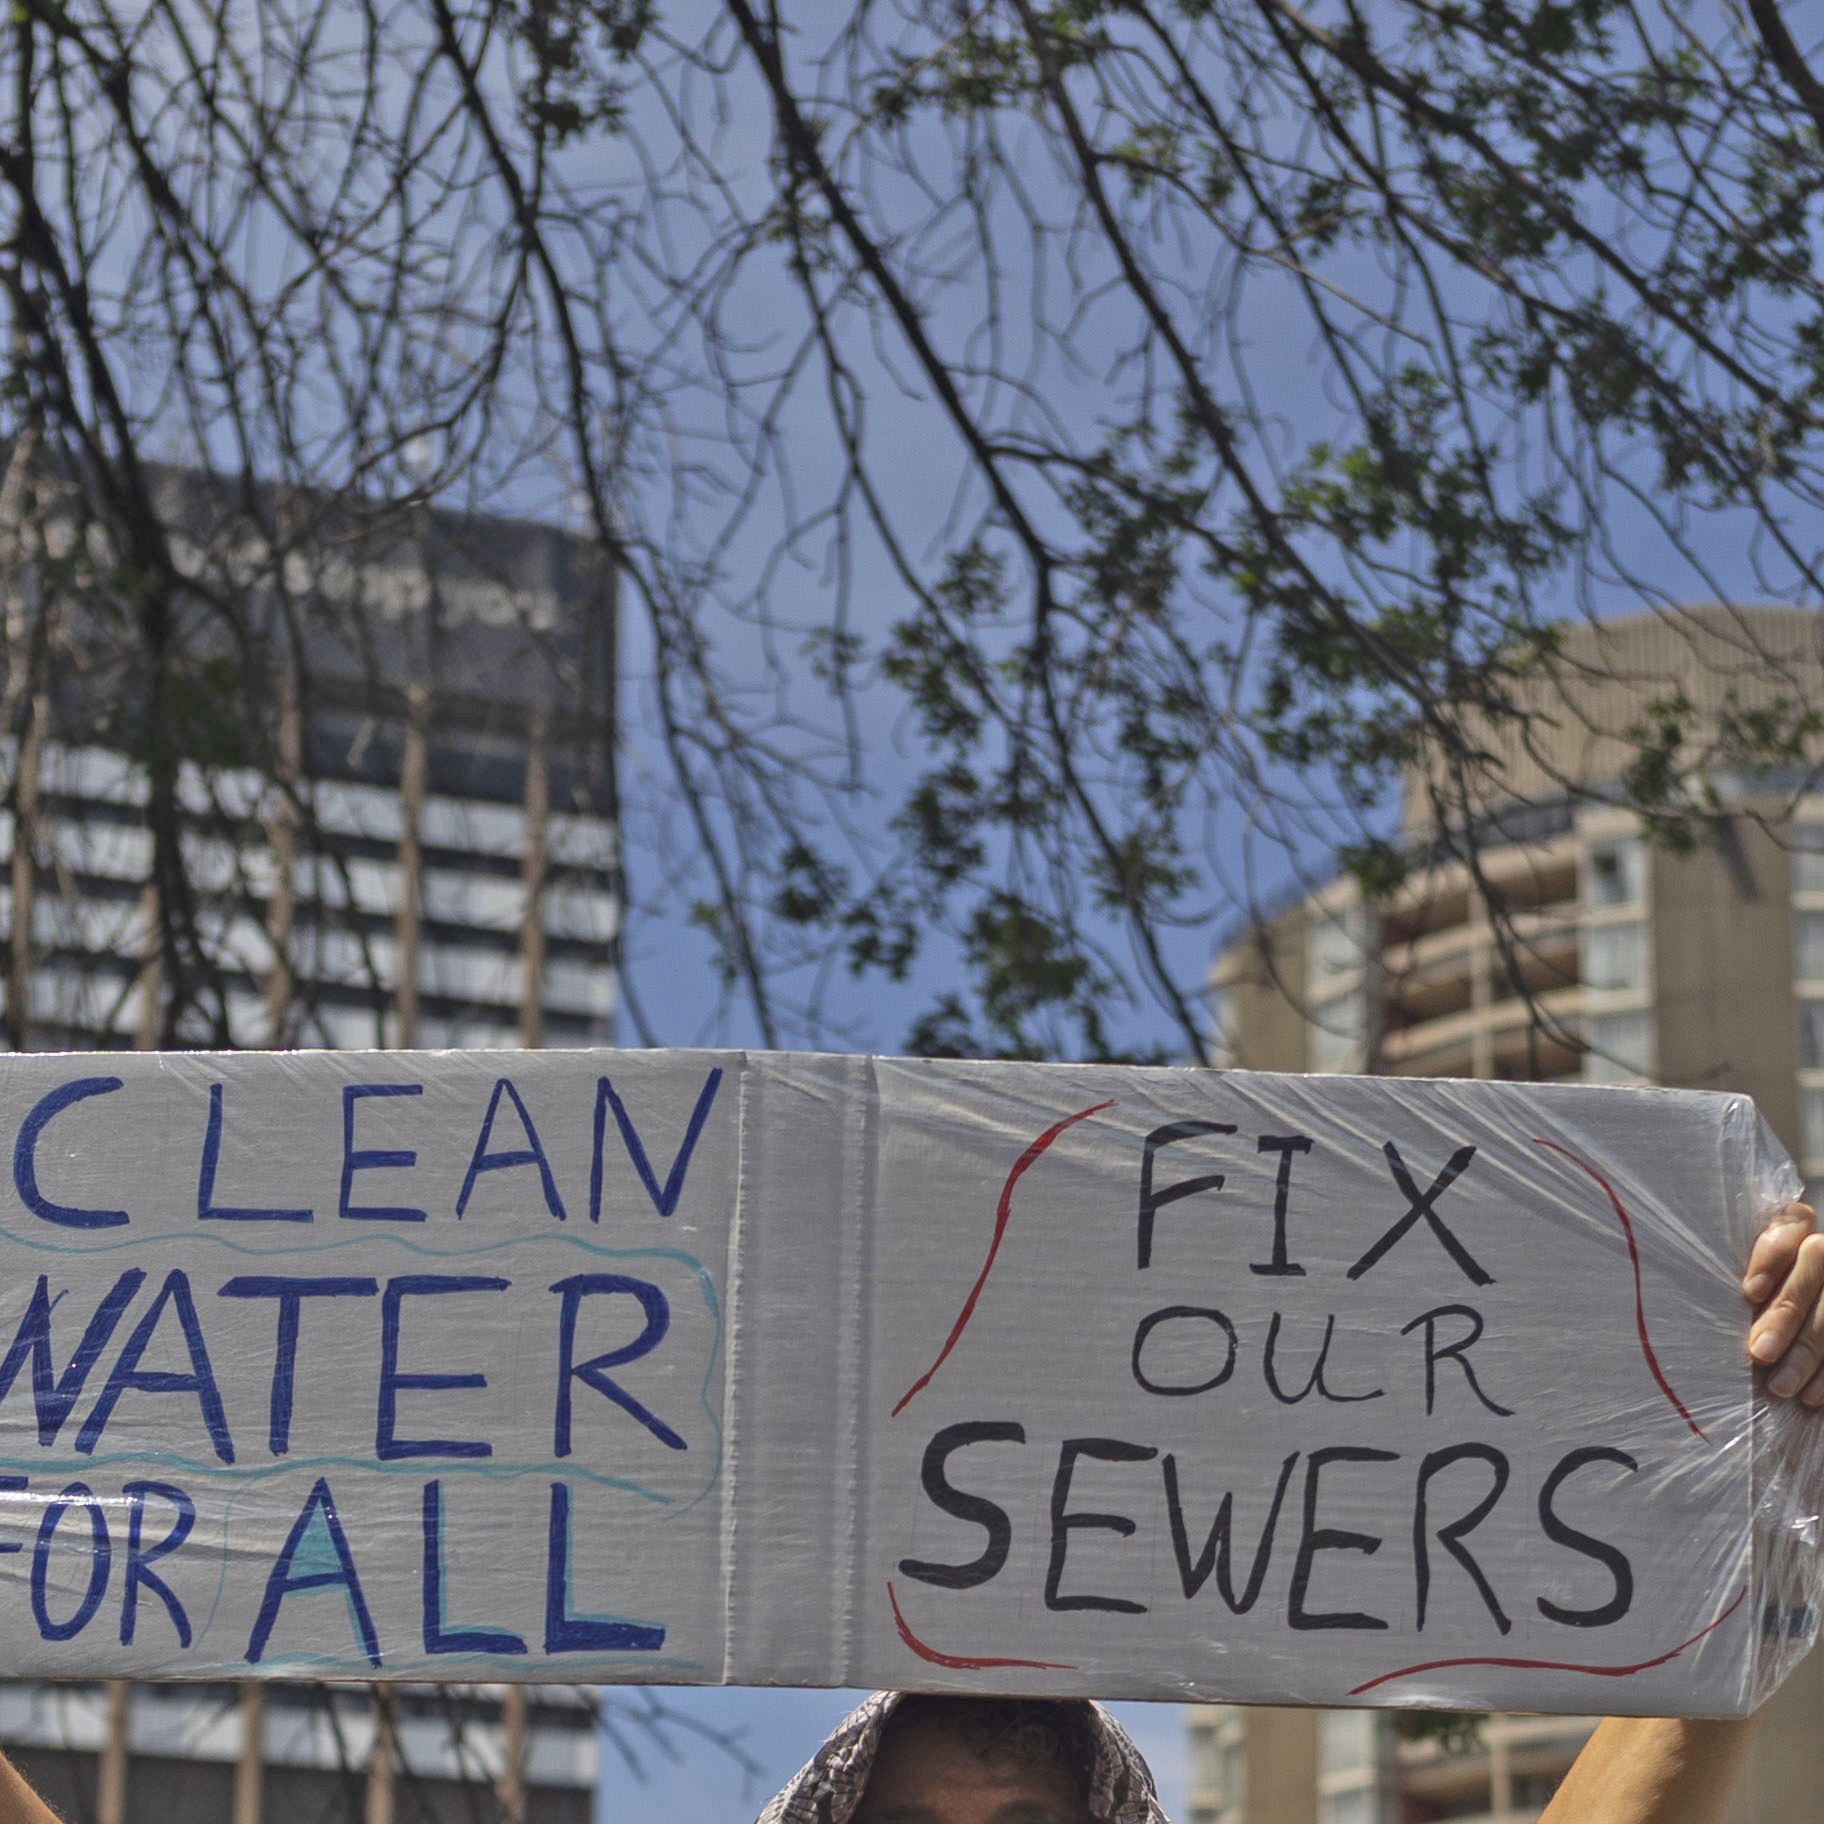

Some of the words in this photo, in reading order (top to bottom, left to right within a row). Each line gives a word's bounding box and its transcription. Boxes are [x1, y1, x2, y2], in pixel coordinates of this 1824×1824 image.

[12, 1067, 724, 1229] CLEAN
[1136, 1120, 1496, 1286] FIX
[243, 1477, 666, 1668] ALL
[898, 1420, 1638, 1636] SEWERS
